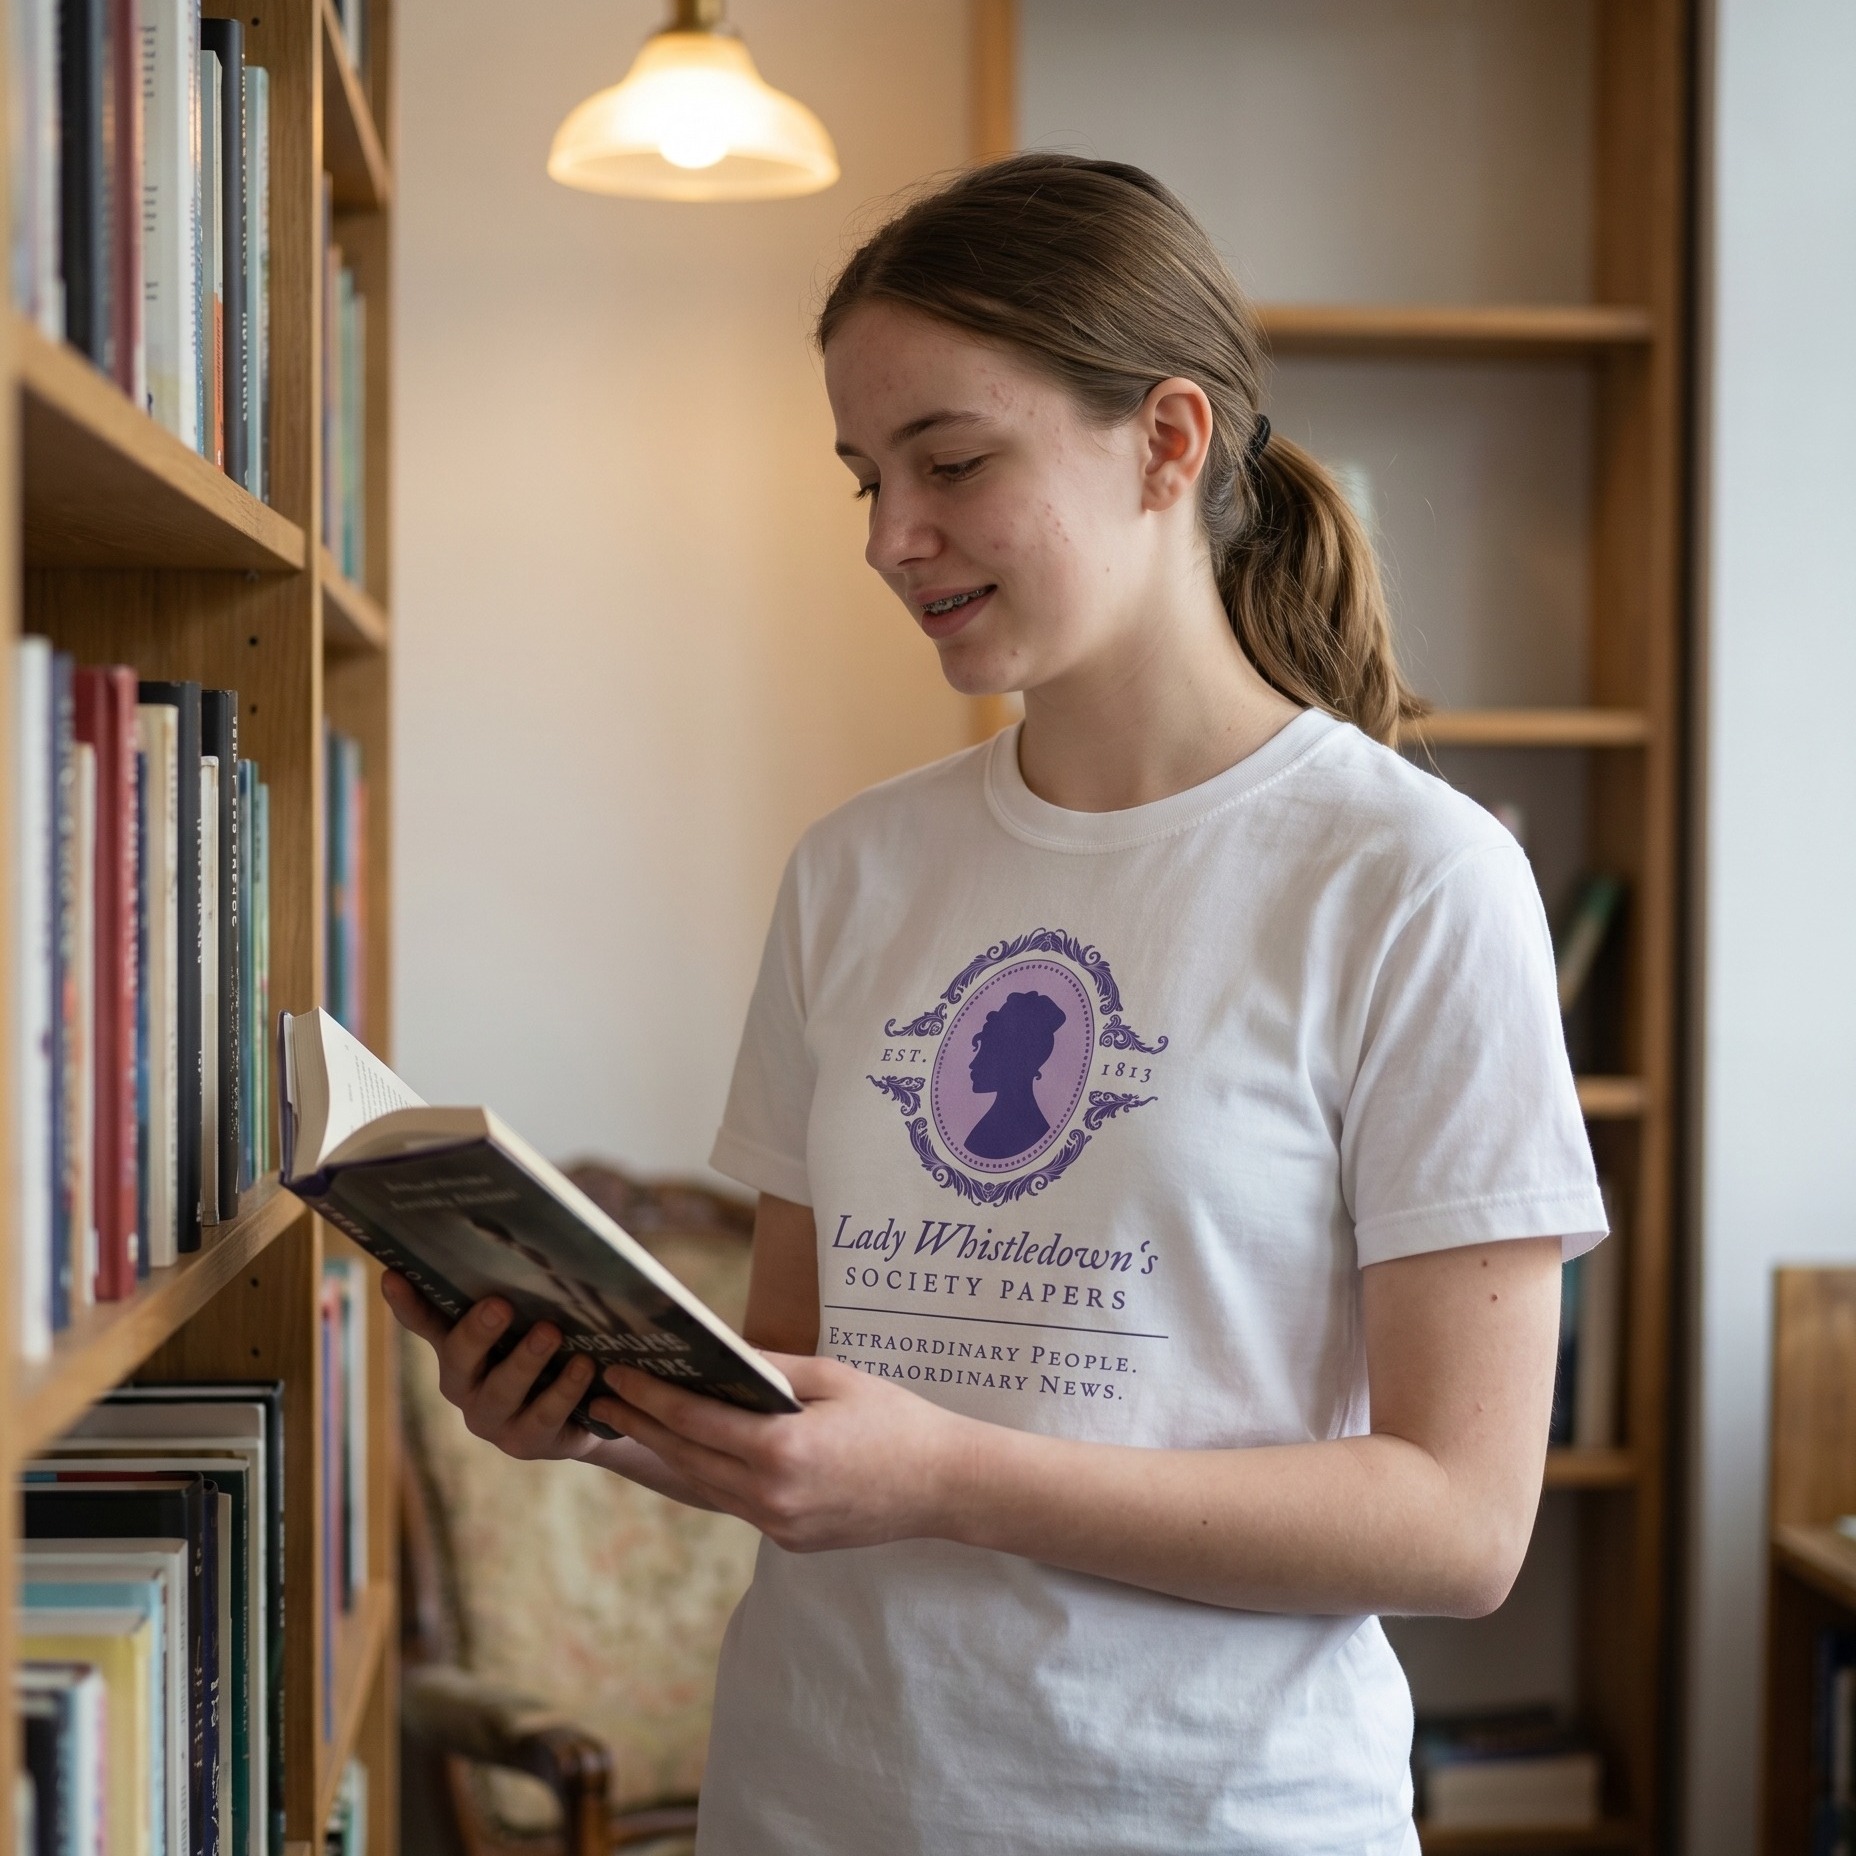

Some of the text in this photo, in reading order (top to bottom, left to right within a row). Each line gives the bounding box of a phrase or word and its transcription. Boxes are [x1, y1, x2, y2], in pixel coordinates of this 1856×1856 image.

[881, 1049, 927, 1063] EST.
[1100, 1062, 1151, 1083] 1813
[832, 1215, 906, 1262] Lady
[845, 1267, 1126, 1310] SOCIETY PAPERS
